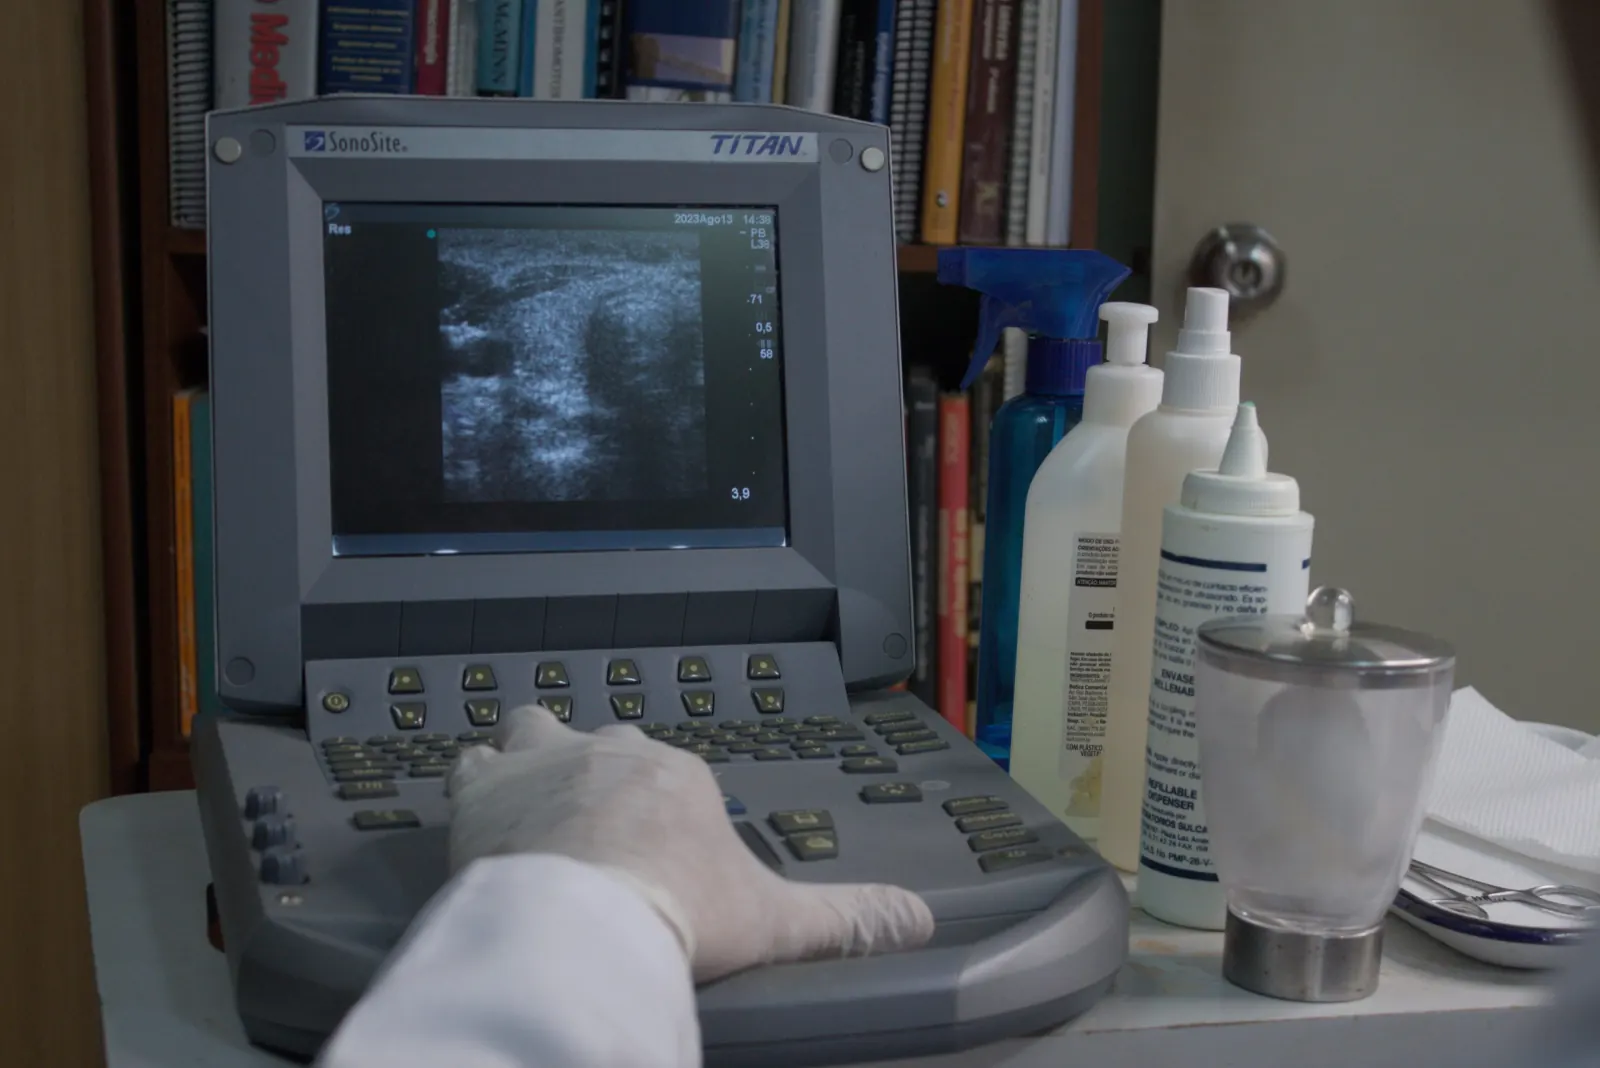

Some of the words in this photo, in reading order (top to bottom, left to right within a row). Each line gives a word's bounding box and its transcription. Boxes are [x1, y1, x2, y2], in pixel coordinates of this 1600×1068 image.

[710, 134, 804, 155] TITAN
[674, 214, 733, 226] 2023Ago13
[328, 223, 352, 235] Res
[731, 487, 750, 501] 3,9
[1161, 669, 1195, 685] ENVASE
